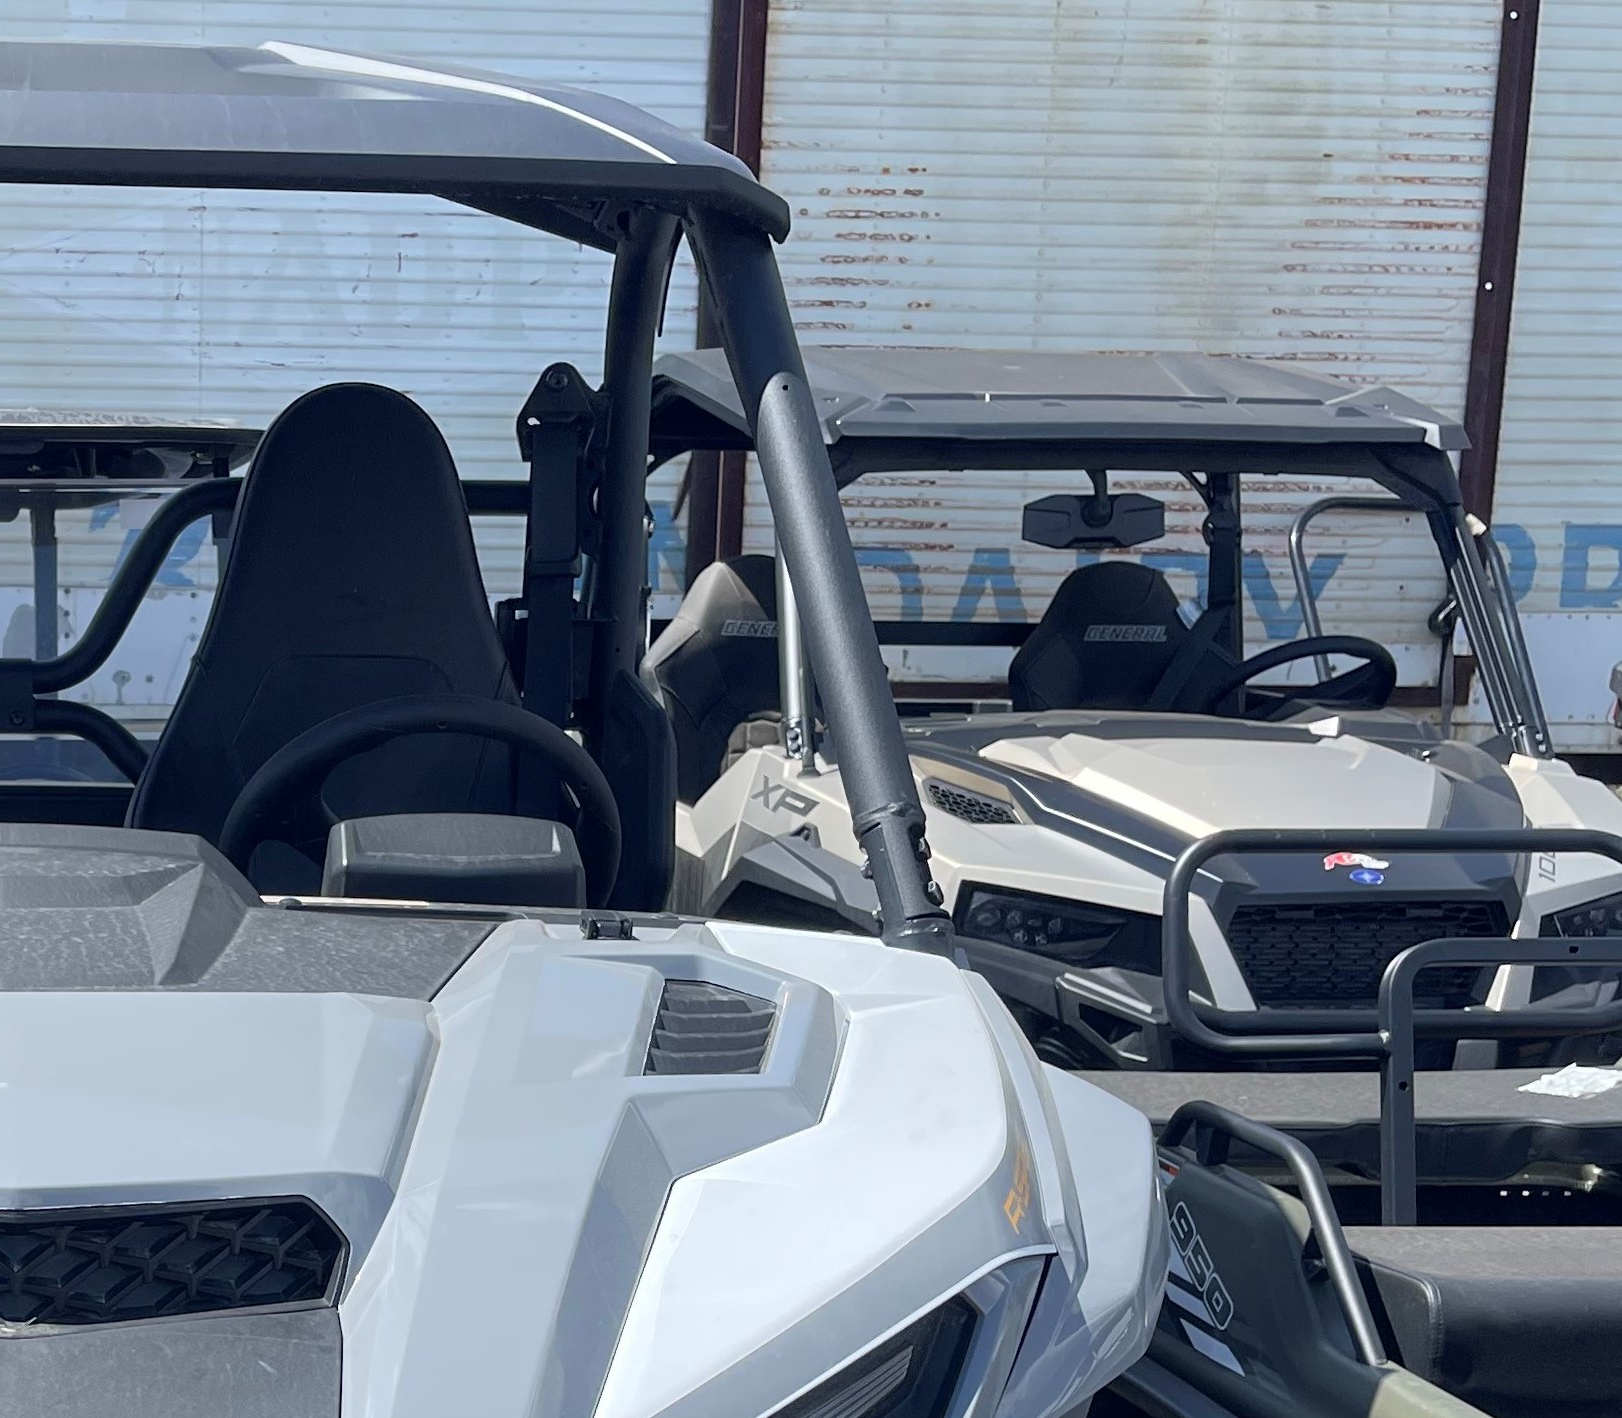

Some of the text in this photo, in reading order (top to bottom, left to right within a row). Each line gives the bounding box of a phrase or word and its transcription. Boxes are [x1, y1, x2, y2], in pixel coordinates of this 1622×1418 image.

[1084, 624, 1168, 642] GENERAL
[749, 773, 820, 817] XP
[1170, 1200, 1234, 1331] 950
